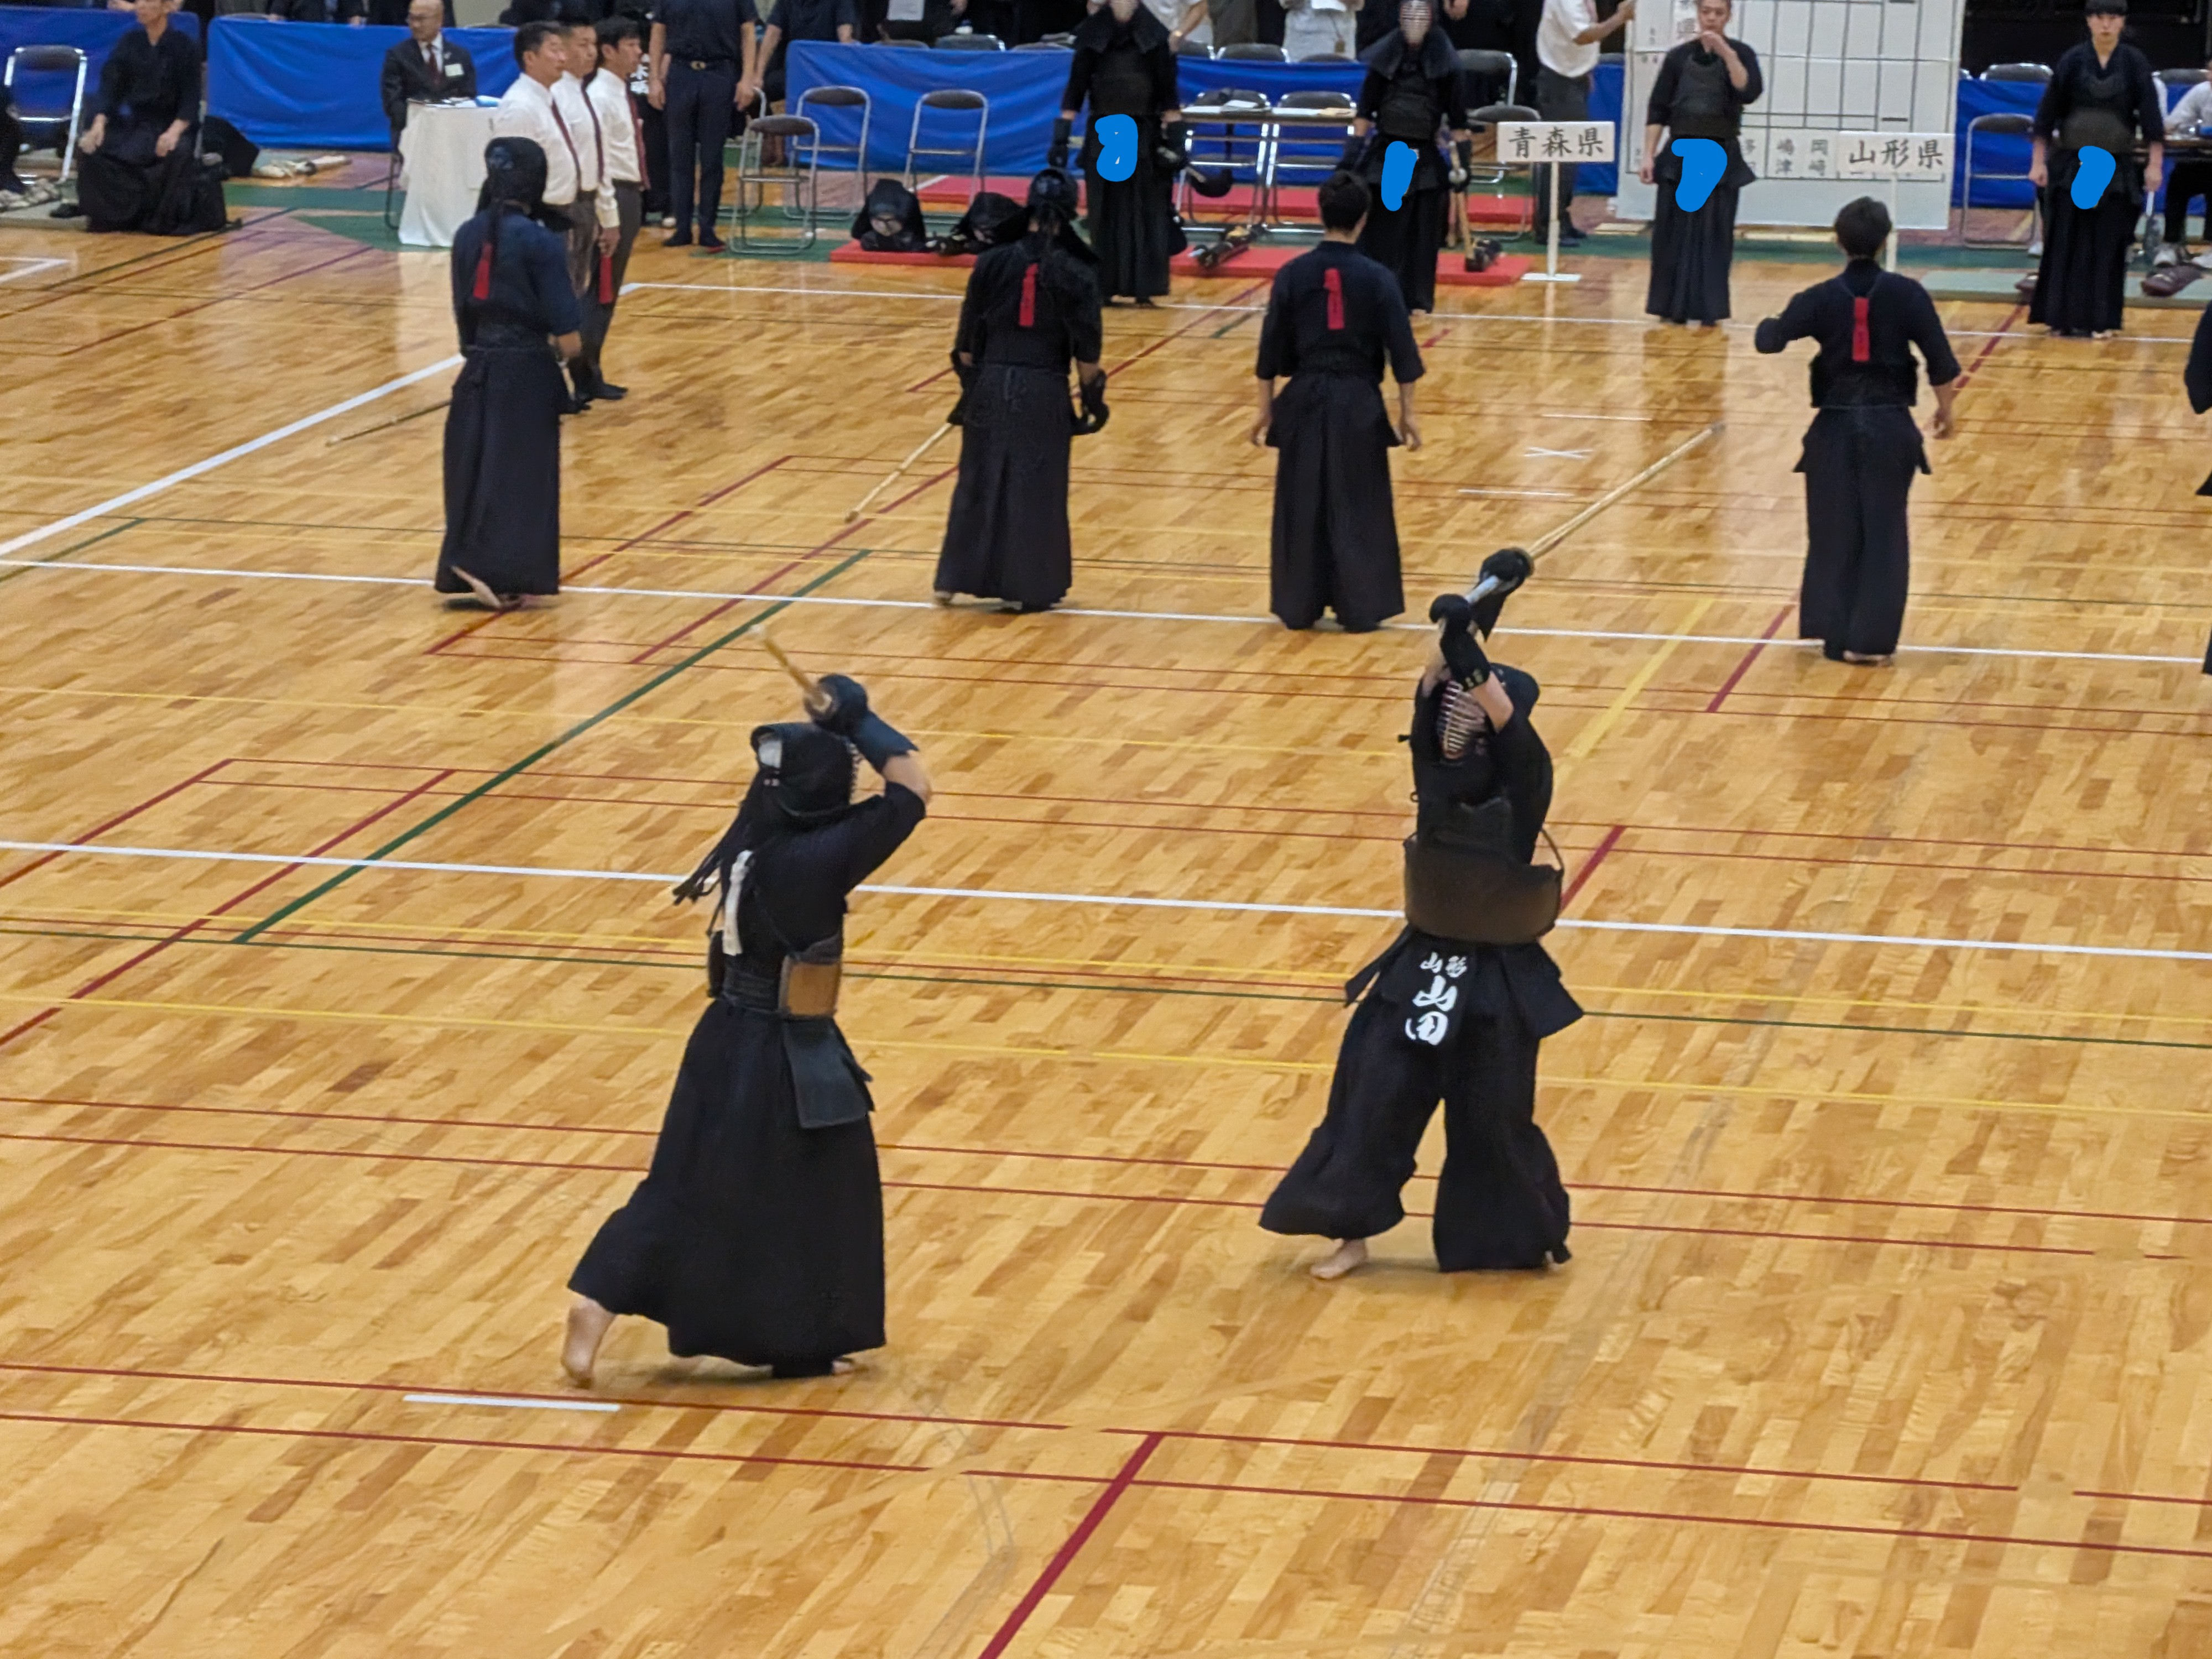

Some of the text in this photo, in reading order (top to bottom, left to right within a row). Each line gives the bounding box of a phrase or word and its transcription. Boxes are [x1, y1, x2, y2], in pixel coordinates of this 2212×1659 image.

[1509, 127, 1603, 159] 青森県
[1850, 139, 1943, 169] 山形県
[1420, 951, 1467, 978] 山形
